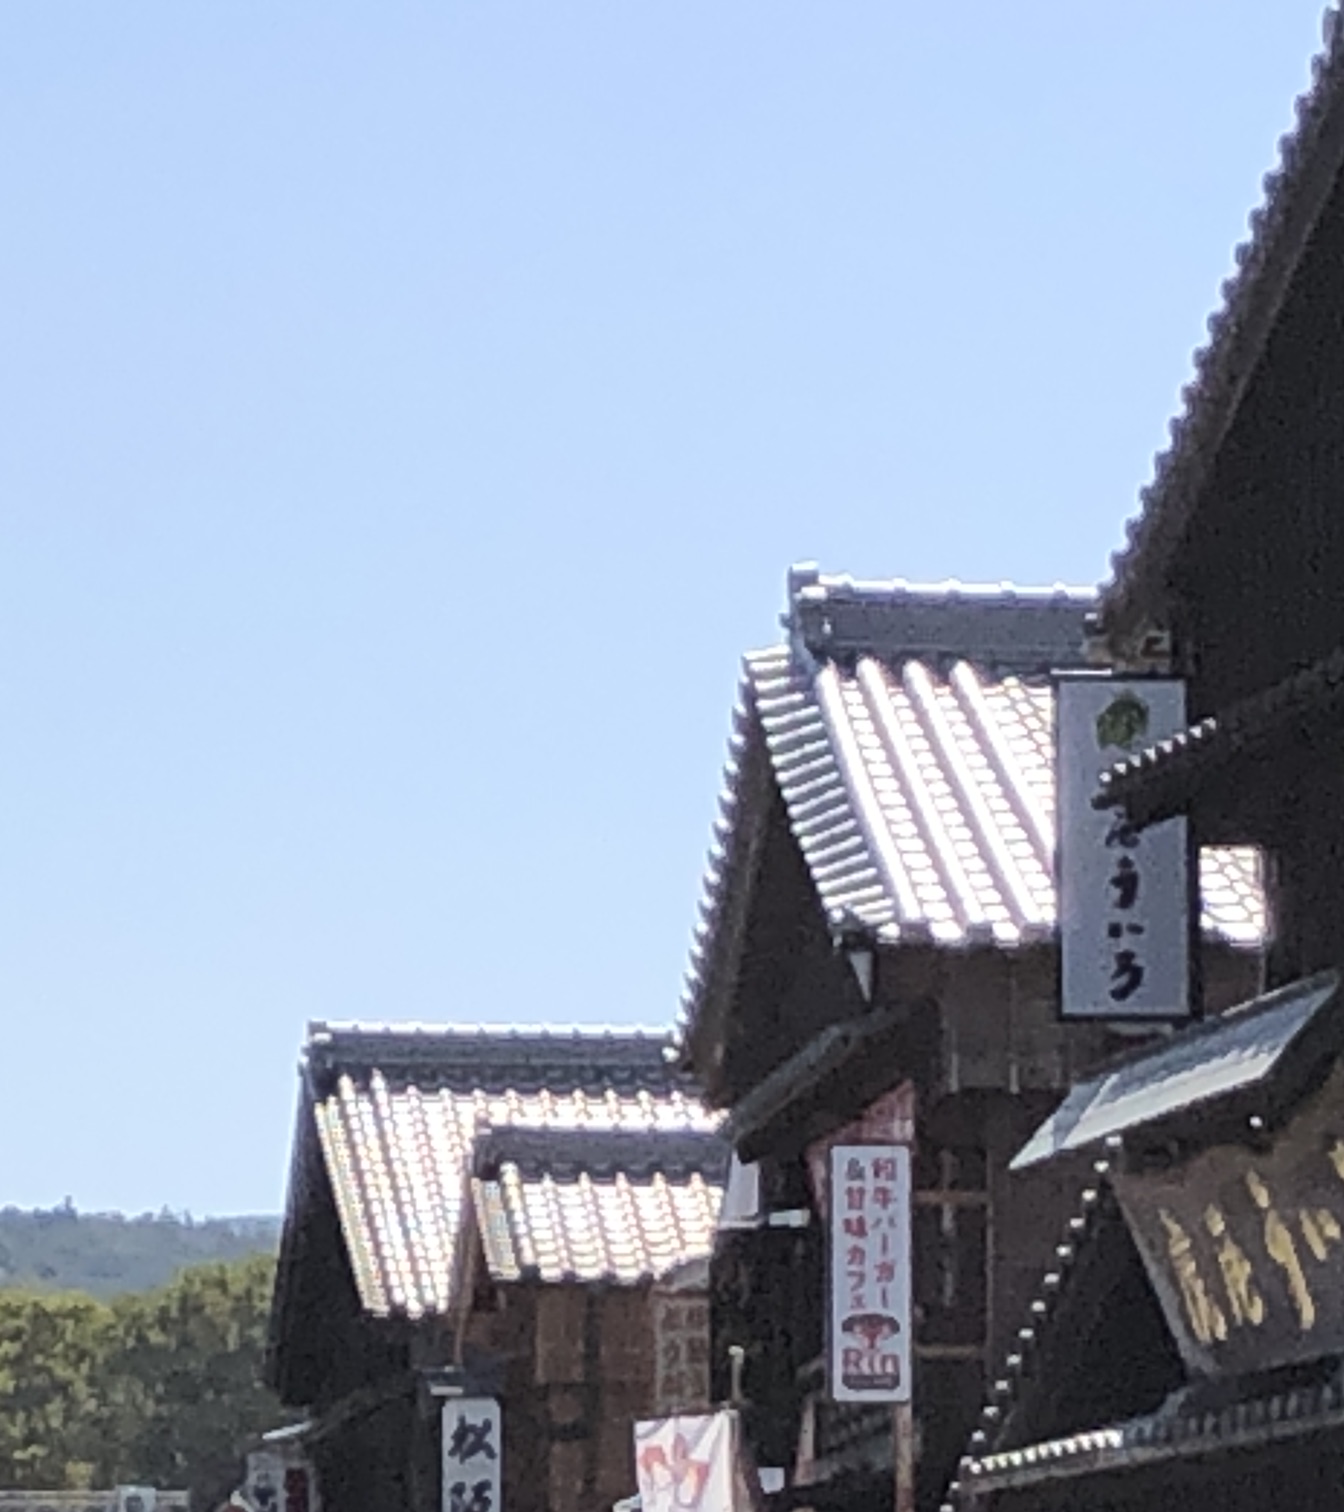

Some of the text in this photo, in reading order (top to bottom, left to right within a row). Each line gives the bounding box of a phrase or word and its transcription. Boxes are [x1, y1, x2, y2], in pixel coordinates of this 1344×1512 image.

[871, 1156, 898, 1310] 和牛バーガー
